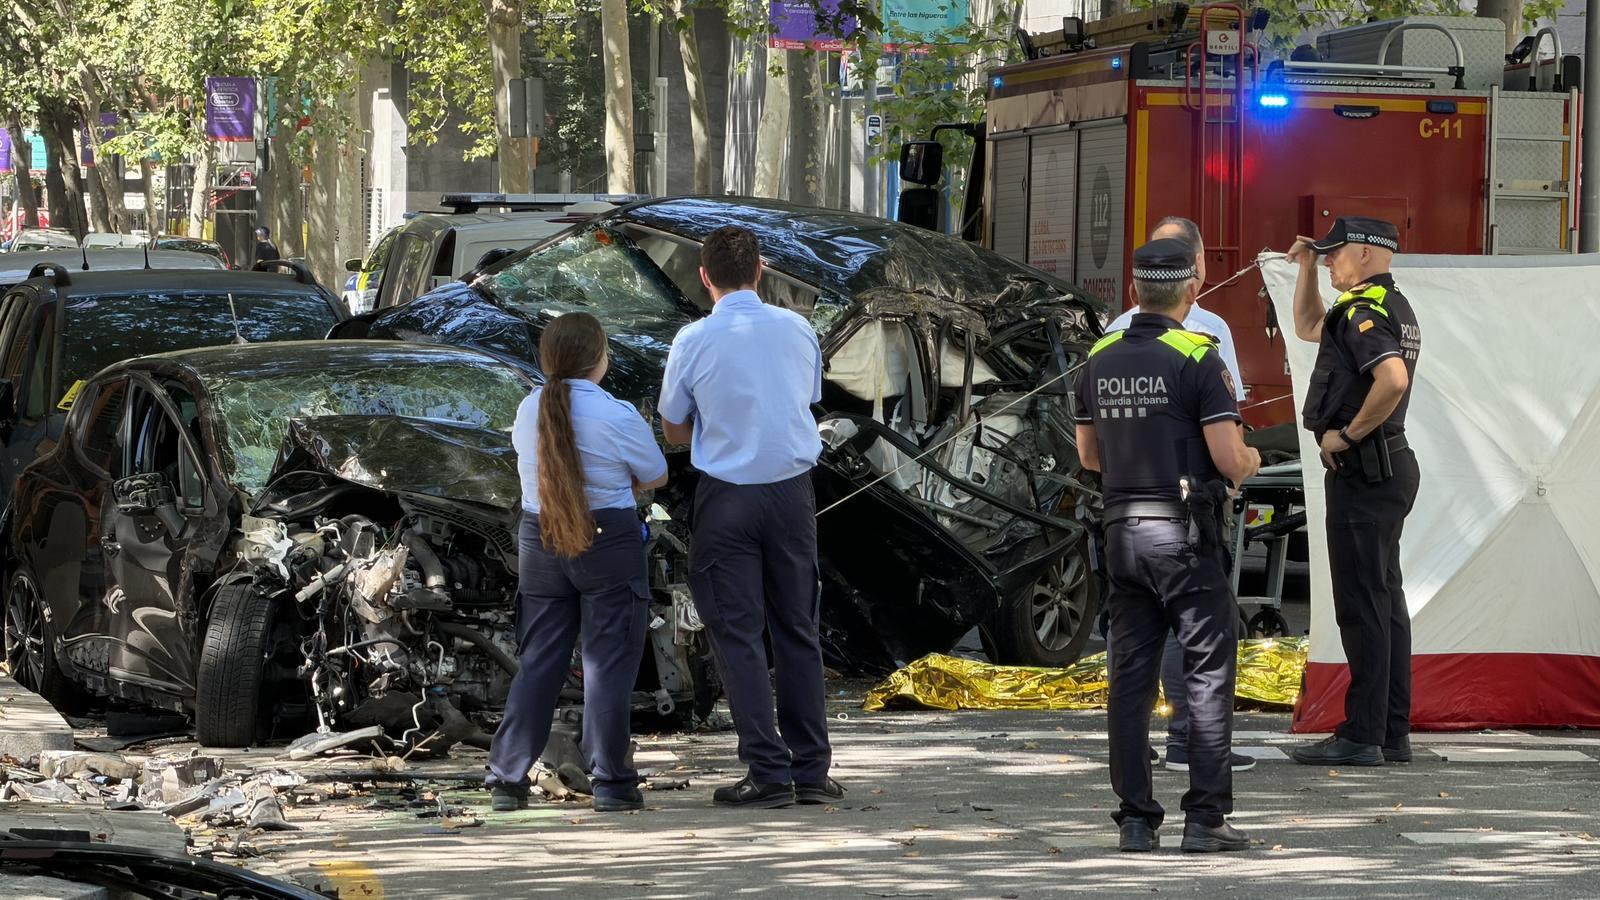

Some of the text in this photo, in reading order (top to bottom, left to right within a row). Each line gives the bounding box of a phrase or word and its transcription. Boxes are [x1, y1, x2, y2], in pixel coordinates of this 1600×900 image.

[889, 10, 907, 18] Entre
[1419, 118, 1462, 138] C-11
[1094, 193, 1108, 227] 112
[1097, 376, 1167, 395] POLICIA
[1133, 396, 1168, 405] Urbana
